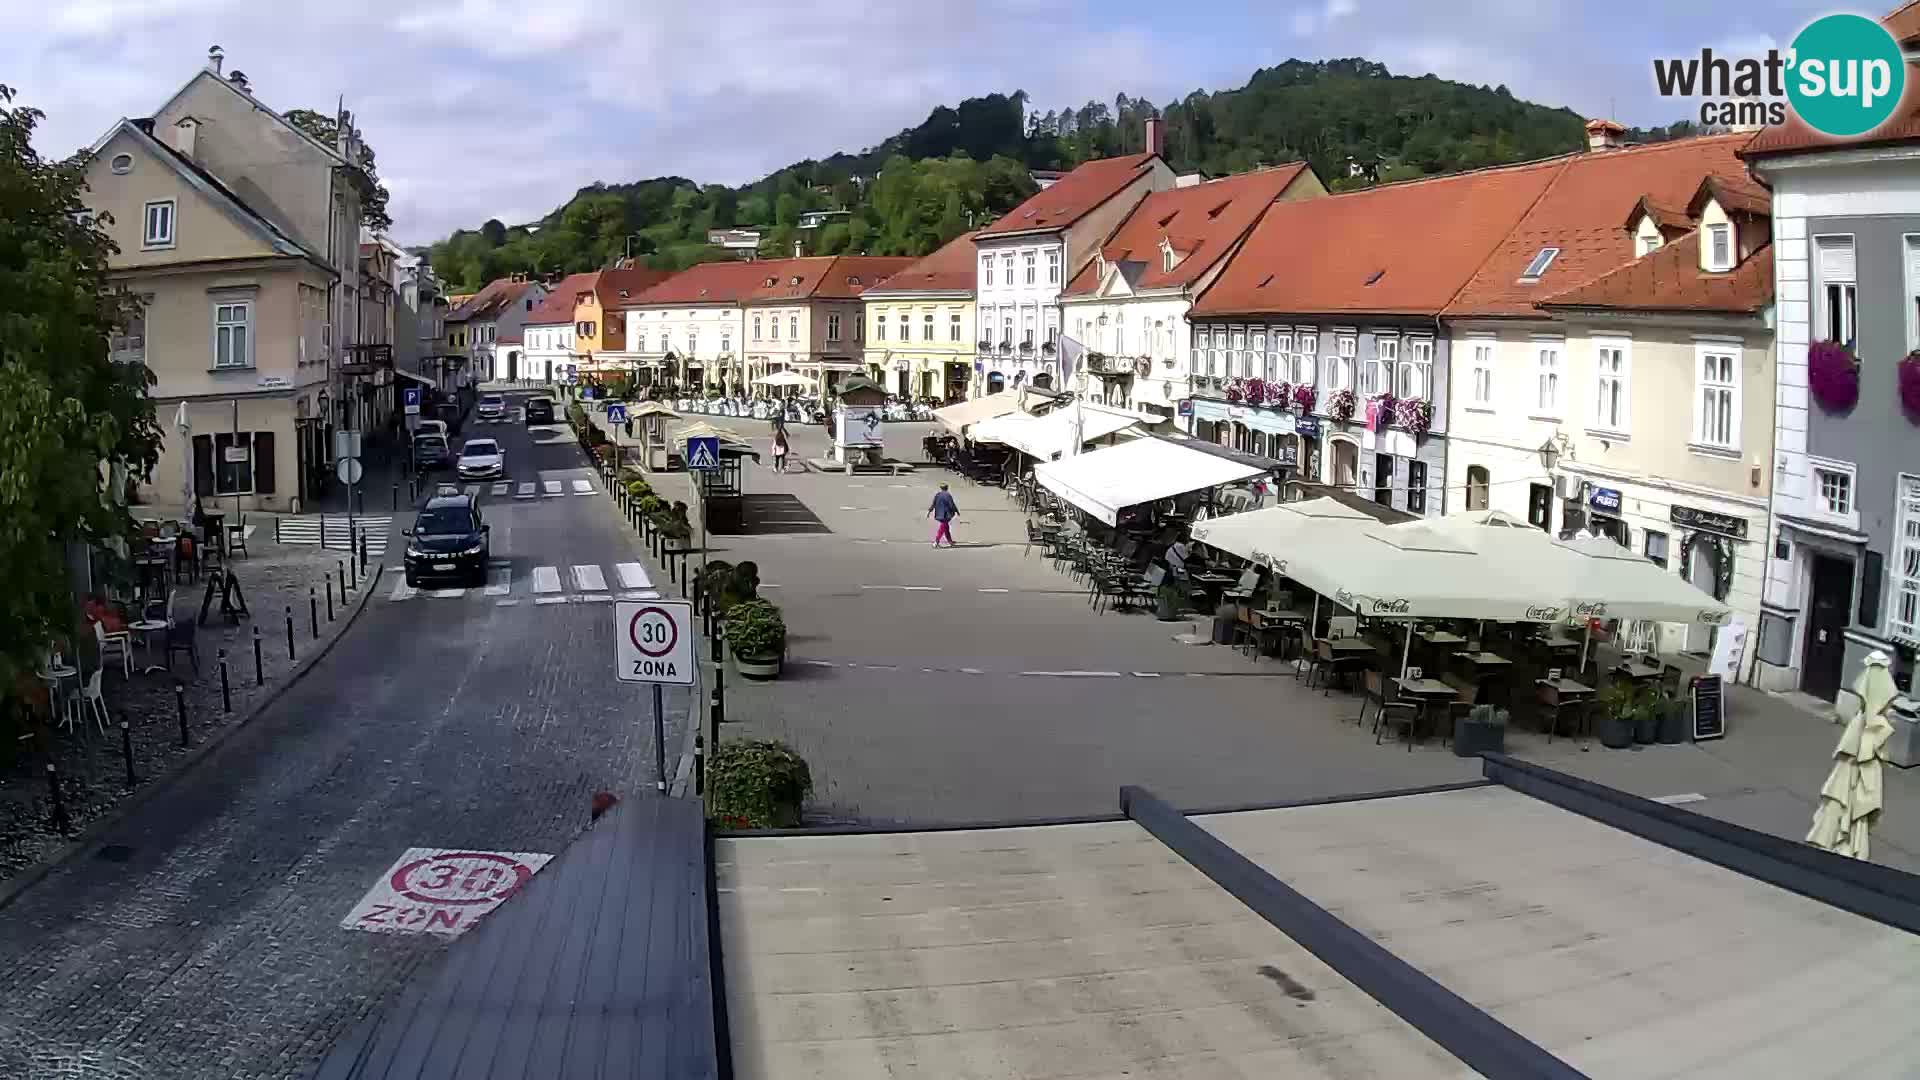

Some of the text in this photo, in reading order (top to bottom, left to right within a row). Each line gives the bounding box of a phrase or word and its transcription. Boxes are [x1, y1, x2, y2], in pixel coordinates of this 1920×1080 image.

[642, 622, 666, 643] 30
[633, 660, 677, 677] ZONA
[418, 864, 505, 893] 30
